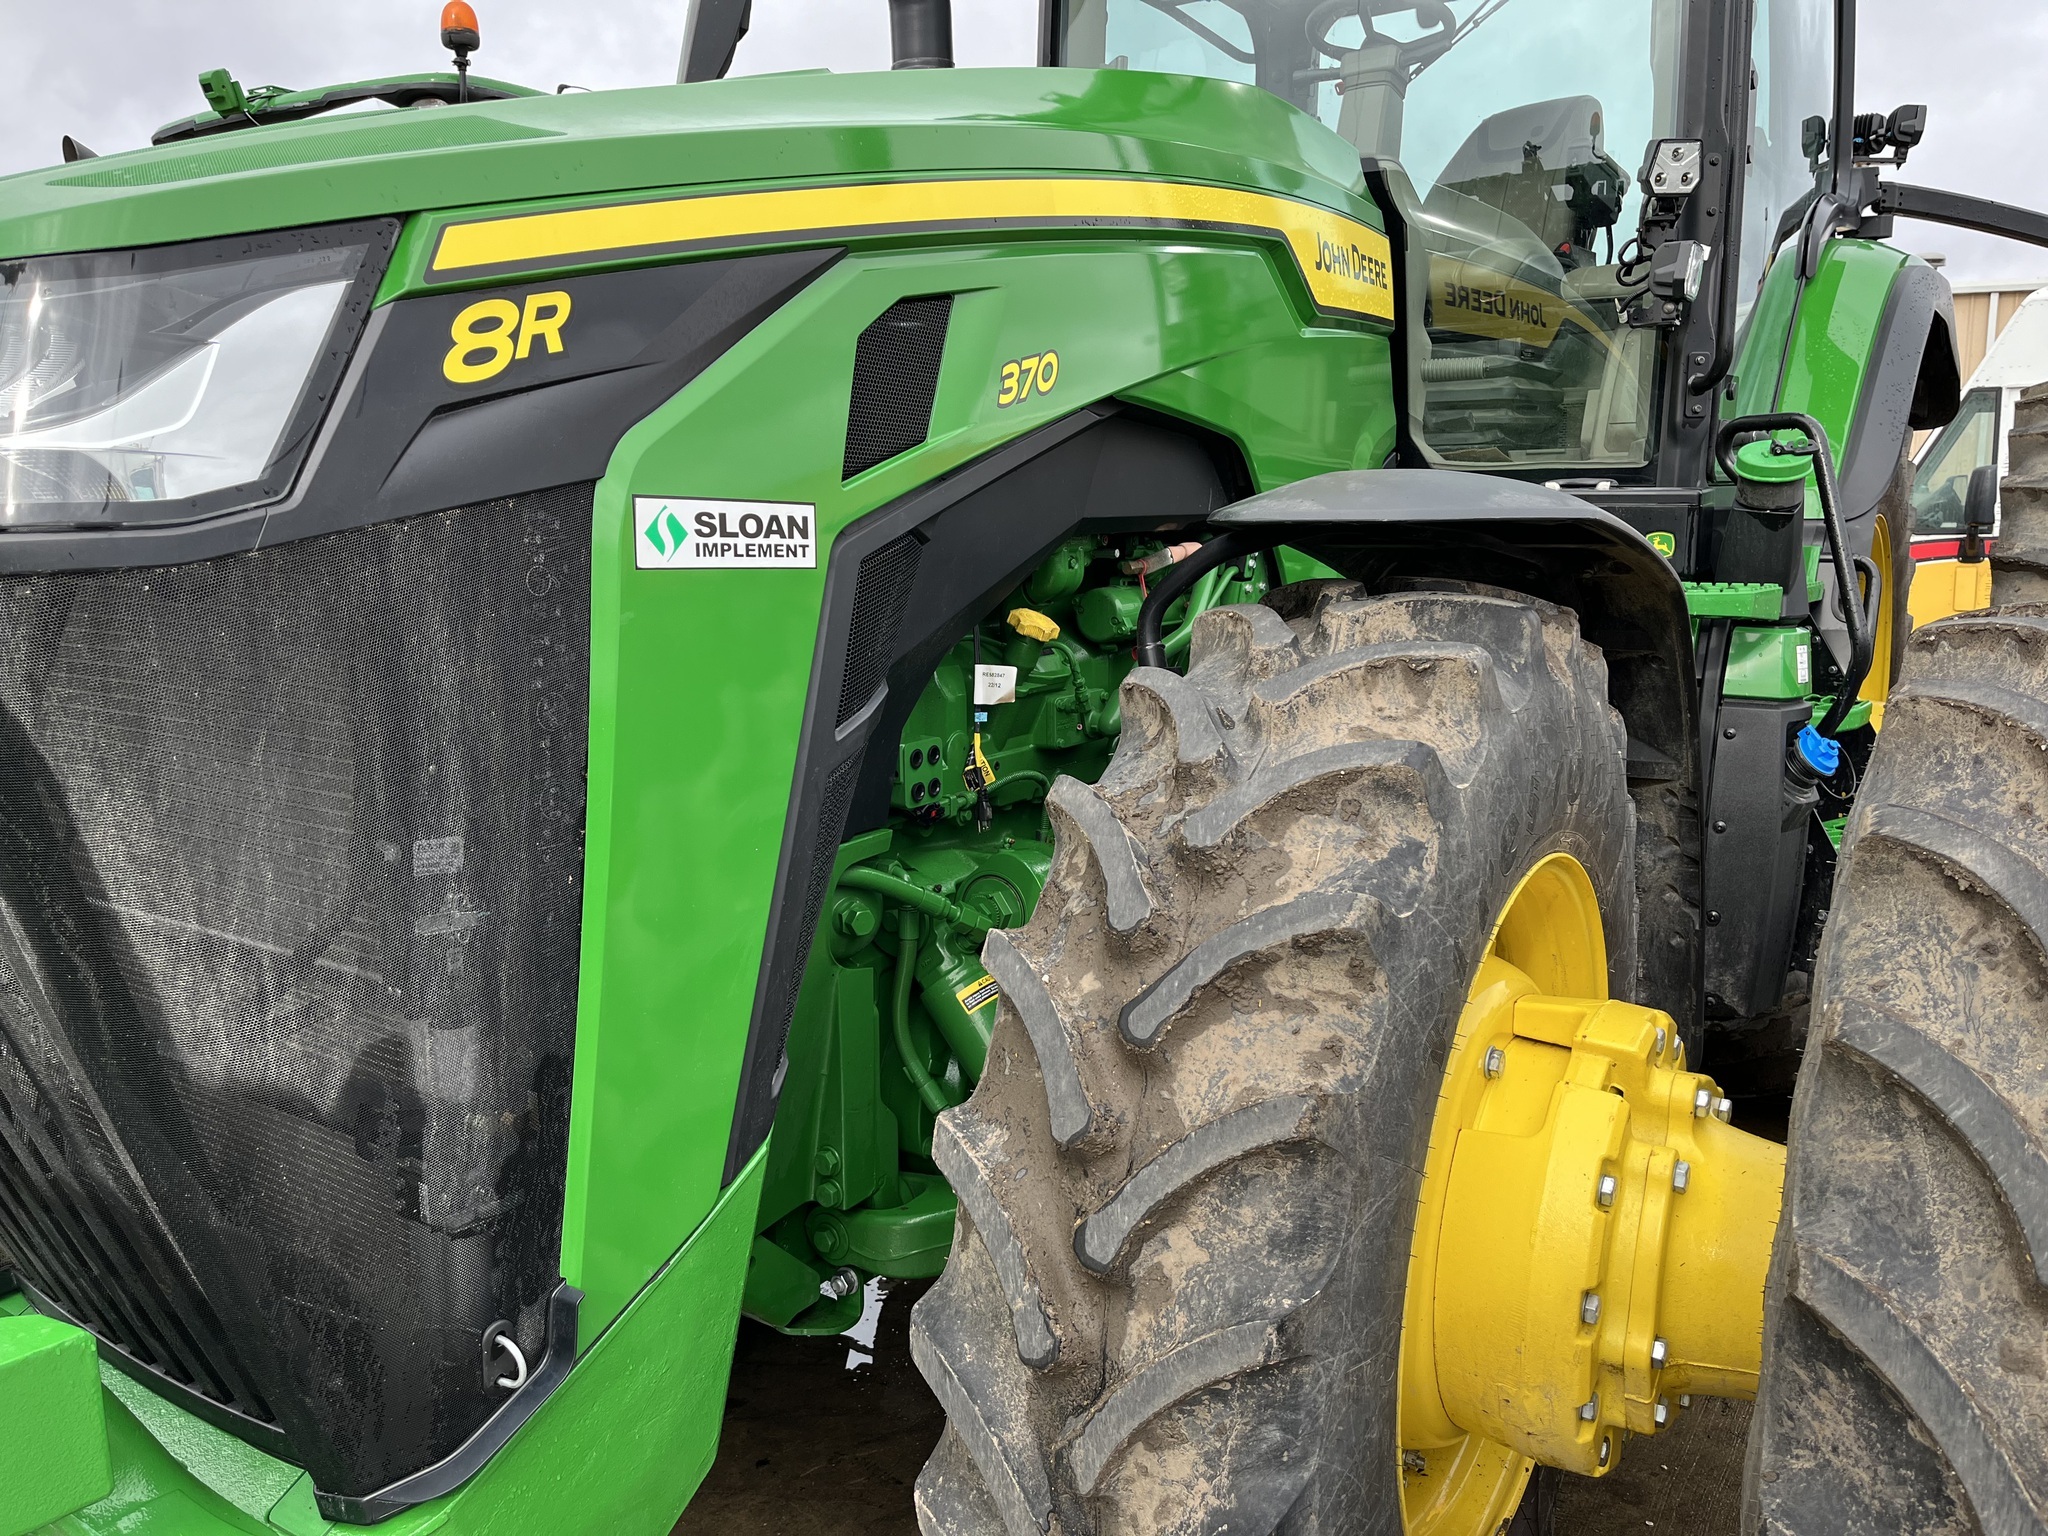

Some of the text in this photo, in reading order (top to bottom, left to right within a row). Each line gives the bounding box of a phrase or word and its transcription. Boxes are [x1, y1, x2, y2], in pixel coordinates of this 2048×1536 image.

[1315, 232, 1387, 290] JOHN DEERE
[443, 290, 571, 383] 8R
[997, 349, 1059, 409] 370
[694, 511, 809, 540] SLOAN
[695, 542, 809, 558] IMPLEMENT
